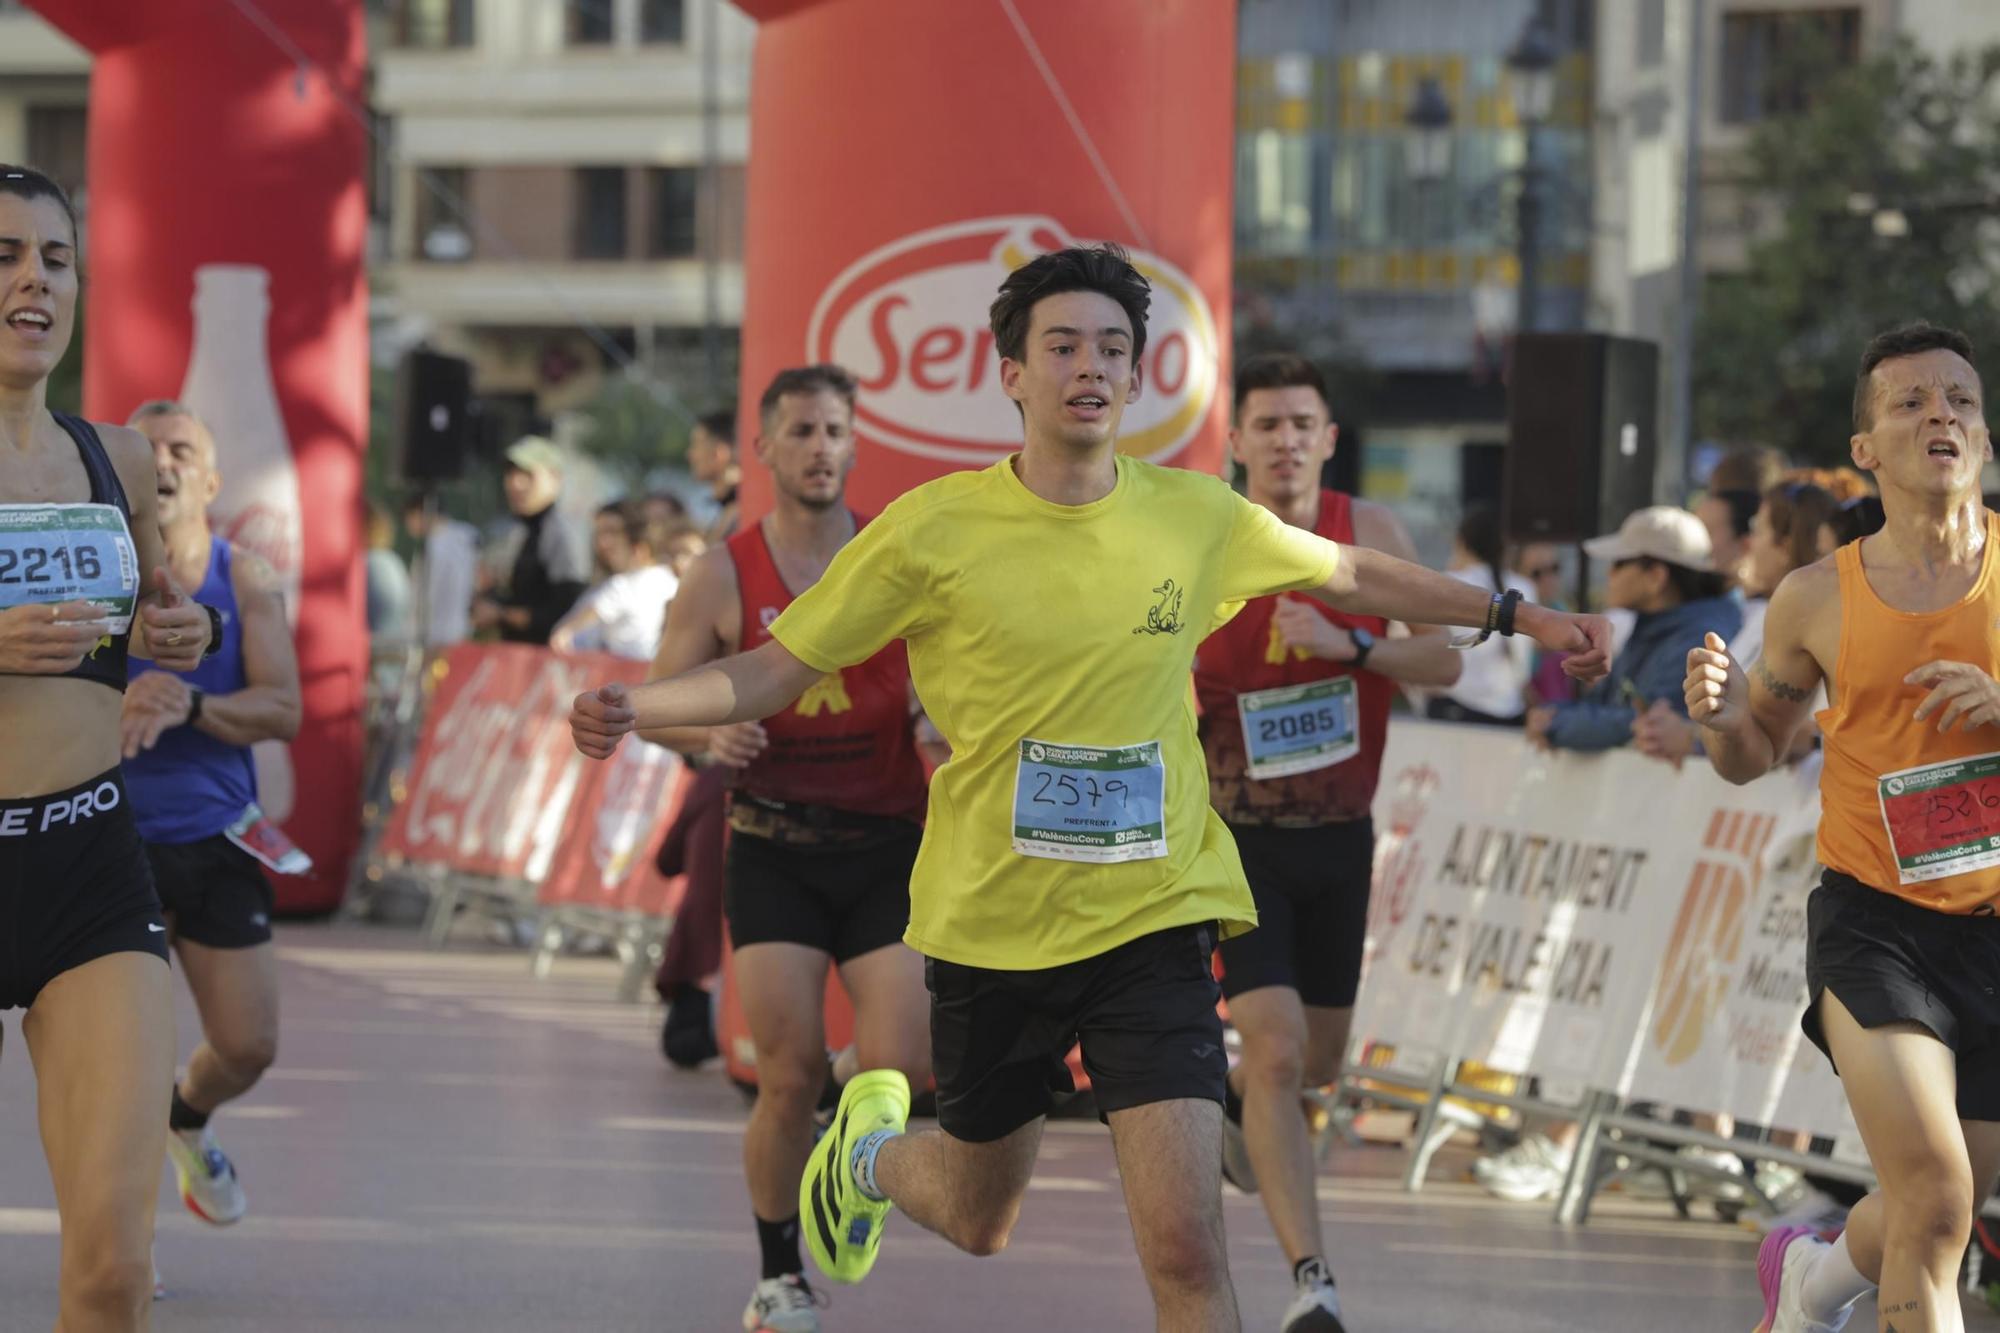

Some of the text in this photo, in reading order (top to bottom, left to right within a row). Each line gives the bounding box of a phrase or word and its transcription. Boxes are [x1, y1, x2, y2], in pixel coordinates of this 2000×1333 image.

[0, 545, 101, 583] 2216
[1260, 708, 1334, 742] 2085
[40, 781, 120, 832] PRO
[1032, 772, 1129, 808] 2579
[1032, 829, 1105, 845] #ValènciaCorre
[1064, 817, 1110, 827] PREFERENT
[1436, 822, 1648, 912] AJUNTAMENT
[1408, 914, 1458, 976] DE
